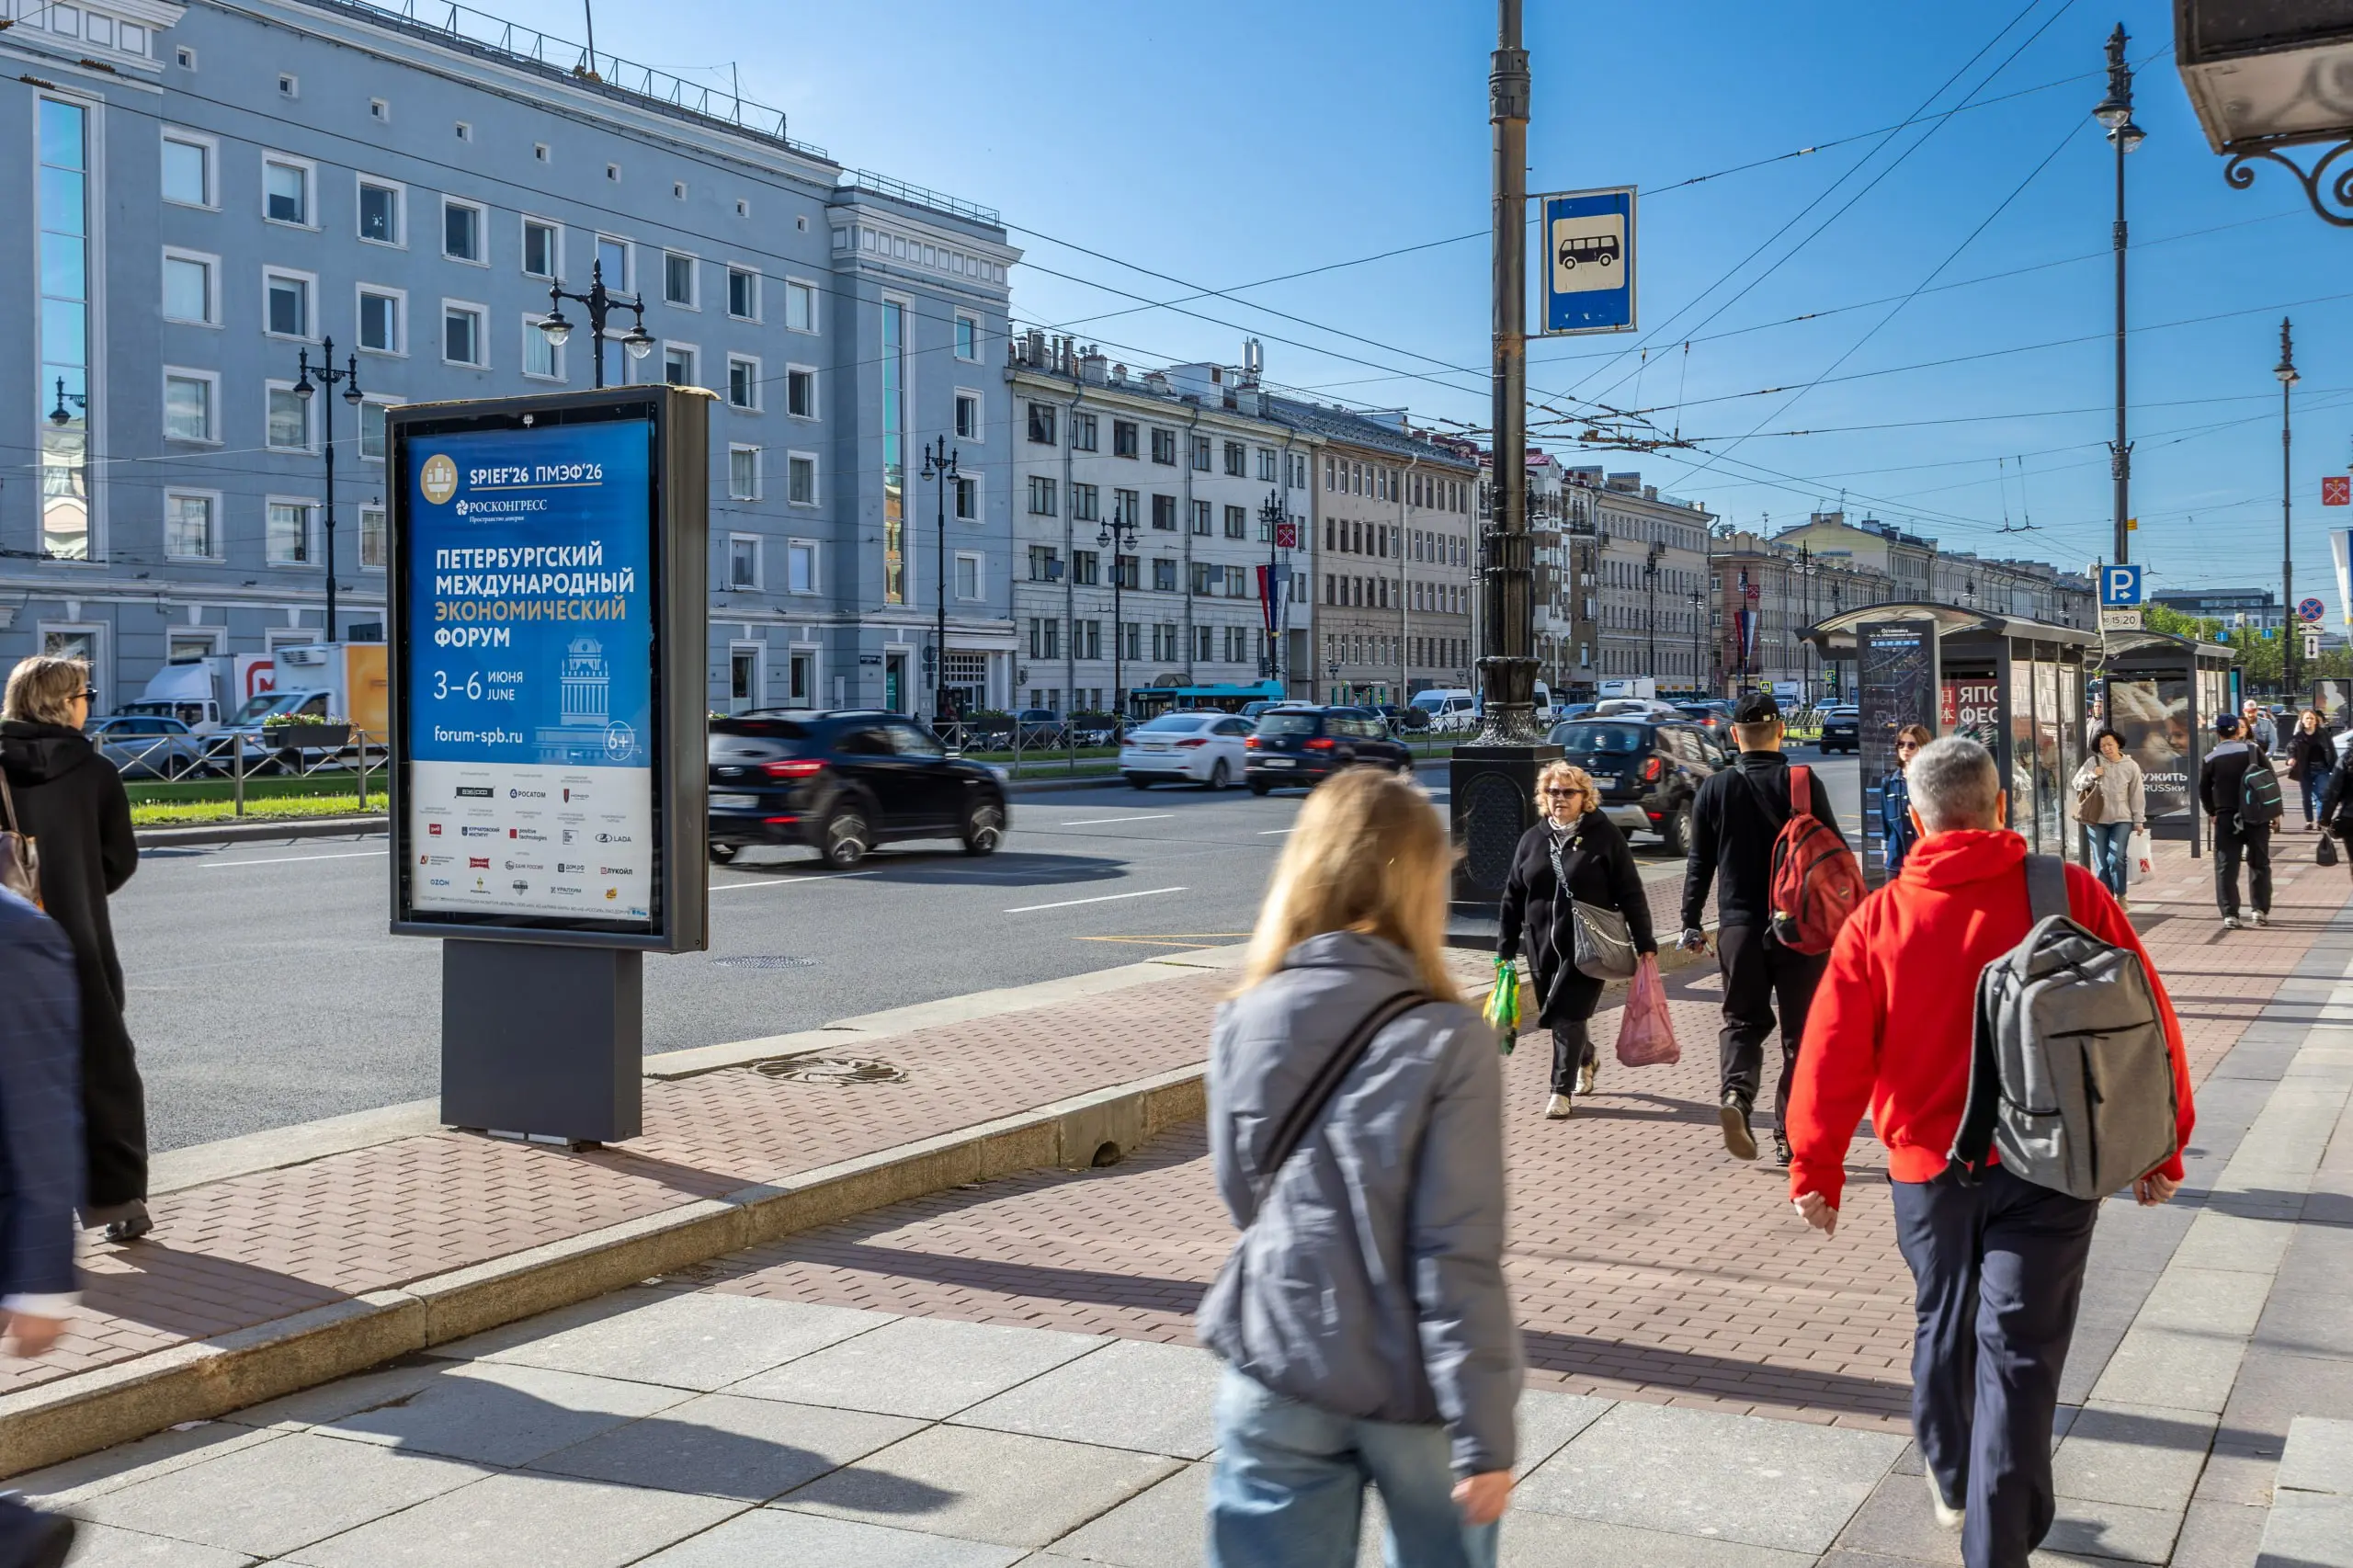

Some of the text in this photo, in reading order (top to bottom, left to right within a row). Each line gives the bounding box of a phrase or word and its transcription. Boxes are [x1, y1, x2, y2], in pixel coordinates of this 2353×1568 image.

[470, 499, 548, 513] РОСКОНГРЕСС
[436, 540, 603, 569] ПЕТЕРБУРГСКИЙ
[436, 567, 634, 597] МЕЖДУНАРОДНЫЙ
[2110, 569, 2133, 600] P
[434, 595, 626, 621] ЭКОНОМИЧЕСКИЙ
[2112, 616, 2120, 624] 15
[2122, 616, 2136, 624] 20
[434, 627, 510, 647] ФОРУМ
[487, 671, 523, 684] ИЮНЯ
[486, 687, 516, 701] JUNE
[434, 725, 523, 747] forum-spb.ru
[608, 730, 629, 750] 6+
[518, 790, 546, 799] РОСАТОМ
[613, 835, 632, 843] LADA
[607, 867, 632, 876] ЛУКОЙЛ
